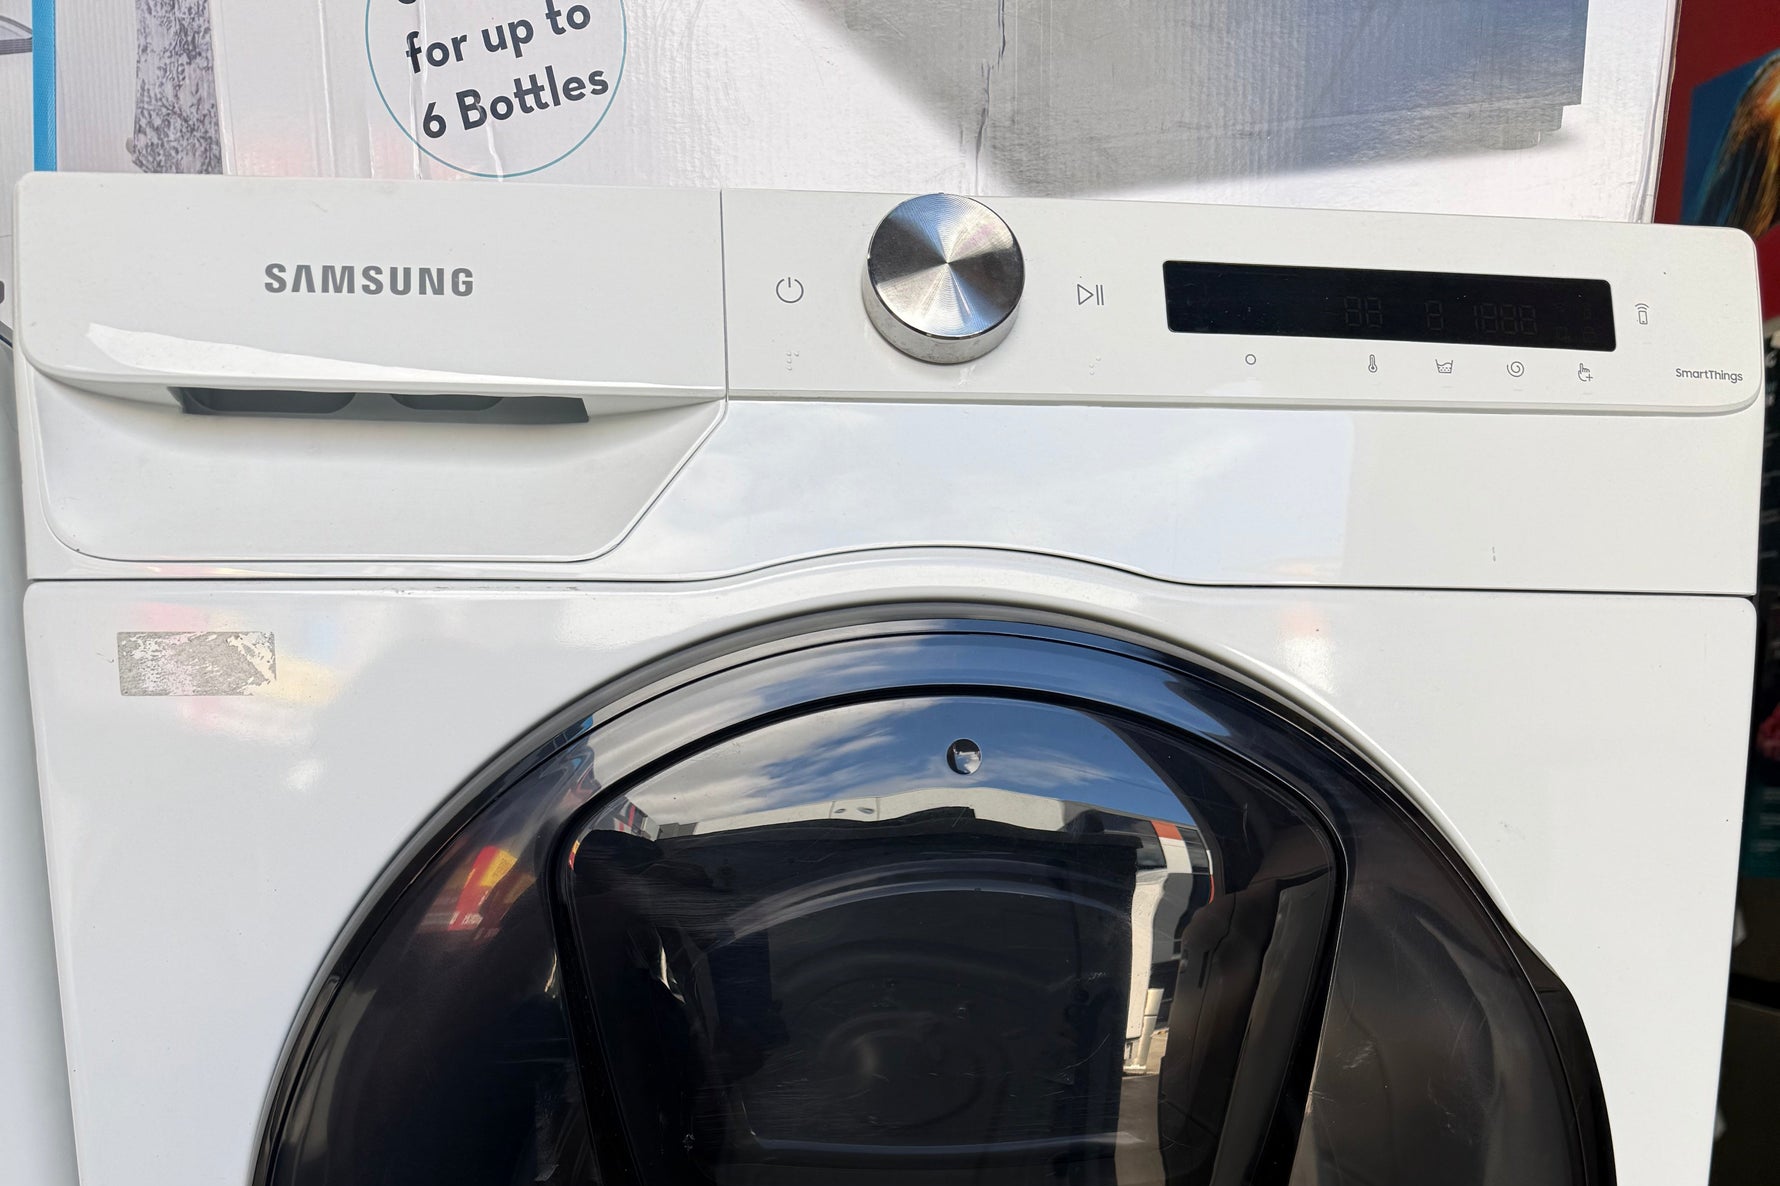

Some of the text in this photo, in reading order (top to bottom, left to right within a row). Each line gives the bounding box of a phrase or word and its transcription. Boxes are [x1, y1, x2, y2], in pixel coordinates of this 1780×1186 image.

[405, 0, 591, 73] for up to
[421, 65, 609, 139] 6 Bottles
[263, 262, 475, 297] SAMSUNG
[1674, 366, 1744, 384] SmartThings
